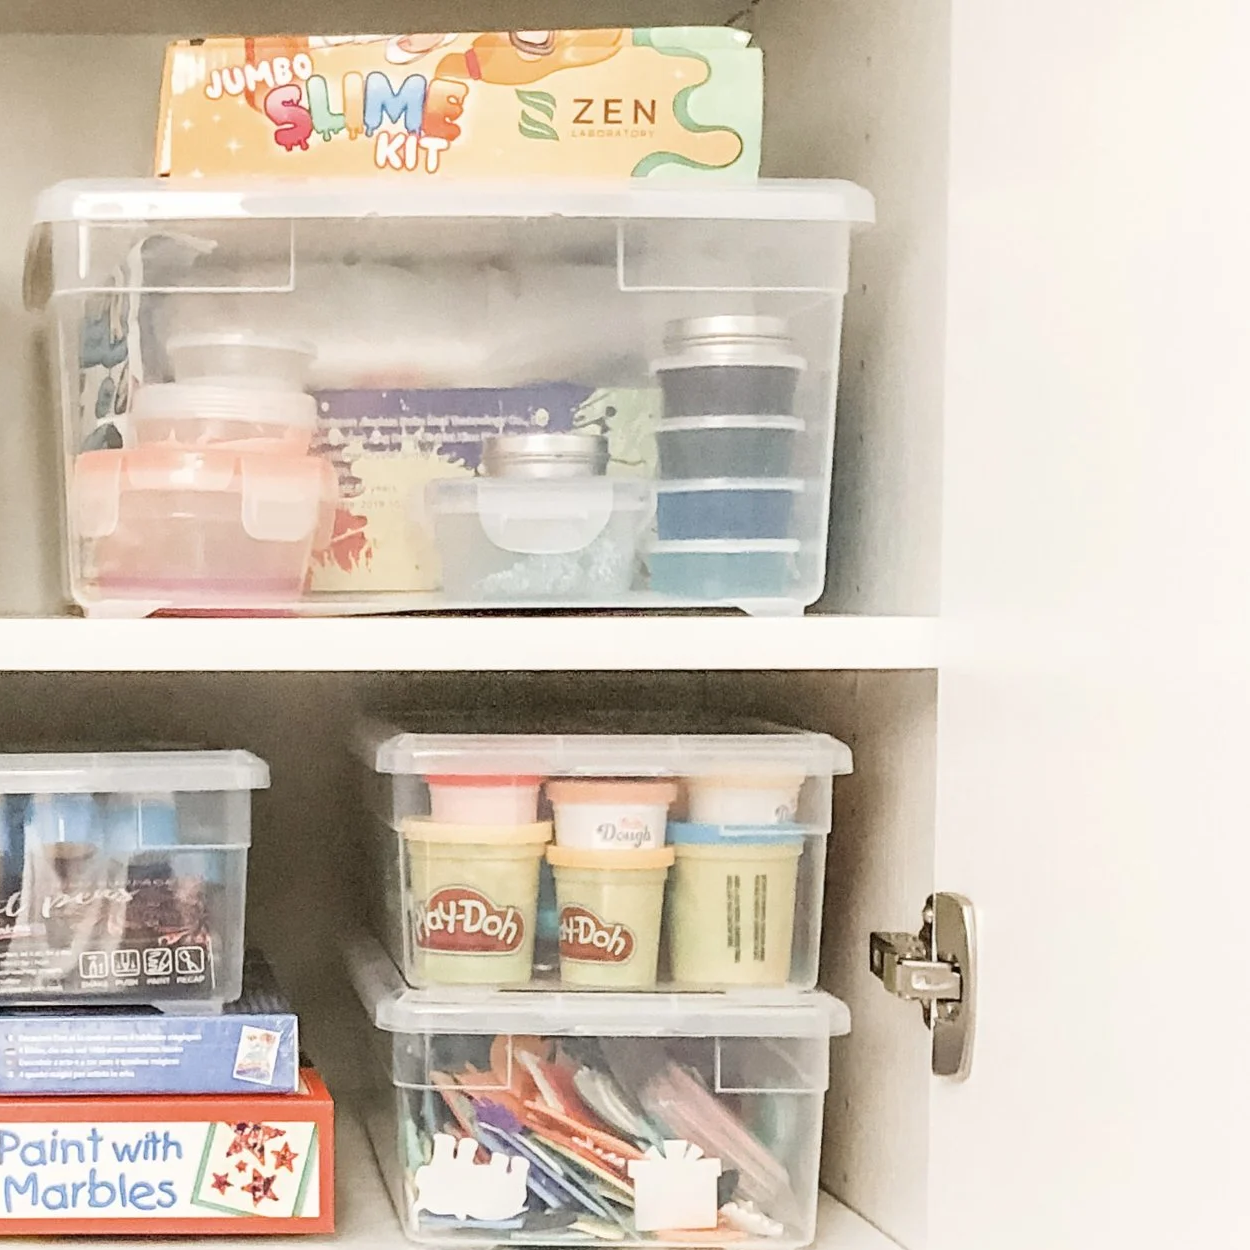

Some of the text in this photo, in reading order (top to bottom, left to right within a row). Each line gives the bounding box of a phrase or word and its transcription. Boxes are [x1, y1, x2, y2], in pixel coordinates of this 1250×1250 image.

[204, 54, 313, 100] JUMBO
[264, 71, 469, 151] SLIME
[572, 98, 656, 124] ZEN
[374, 130, 450, 174] KIT
[571, 129, 654, 138] LABORATORY
[597, 823, 651, 848] Dough
[112, 1130, 182, 1162] with
[4, 1168, 177, 1212] Marbles
